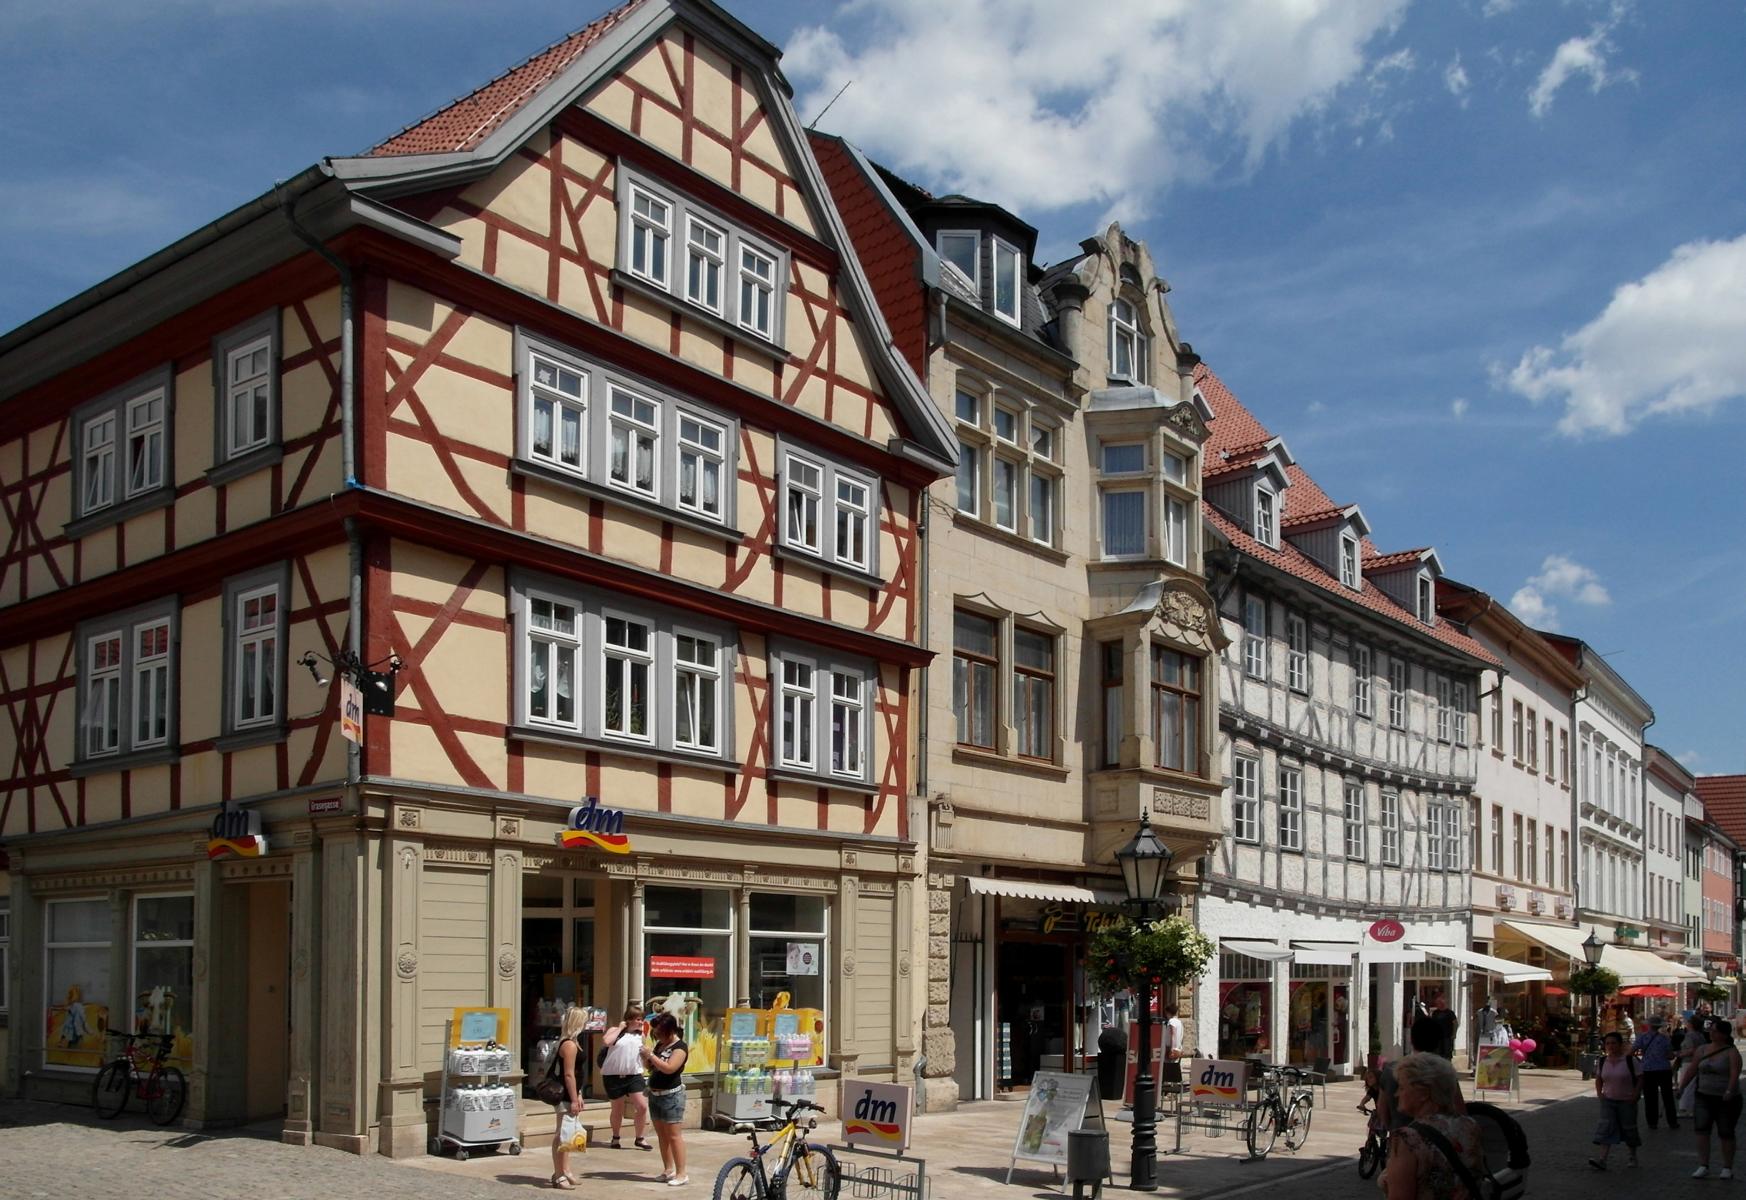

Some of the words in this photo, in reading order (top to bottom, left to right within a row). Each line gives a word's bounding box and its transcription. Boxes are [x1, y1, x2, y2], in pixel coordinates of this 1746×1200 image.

[346, 693, 360, 724] dm
[213, 802, 249, 838] dm
[575, 797, 624, 833] dm
[1083, 911, 1126, 932] Tchib
[1376, 924, 1397, 937] Viba
[1127, 1047, 1161, 1064] SE
[1200, 1064, 1234, 1087] dm
[855, 1089, 897, 1123] dm
